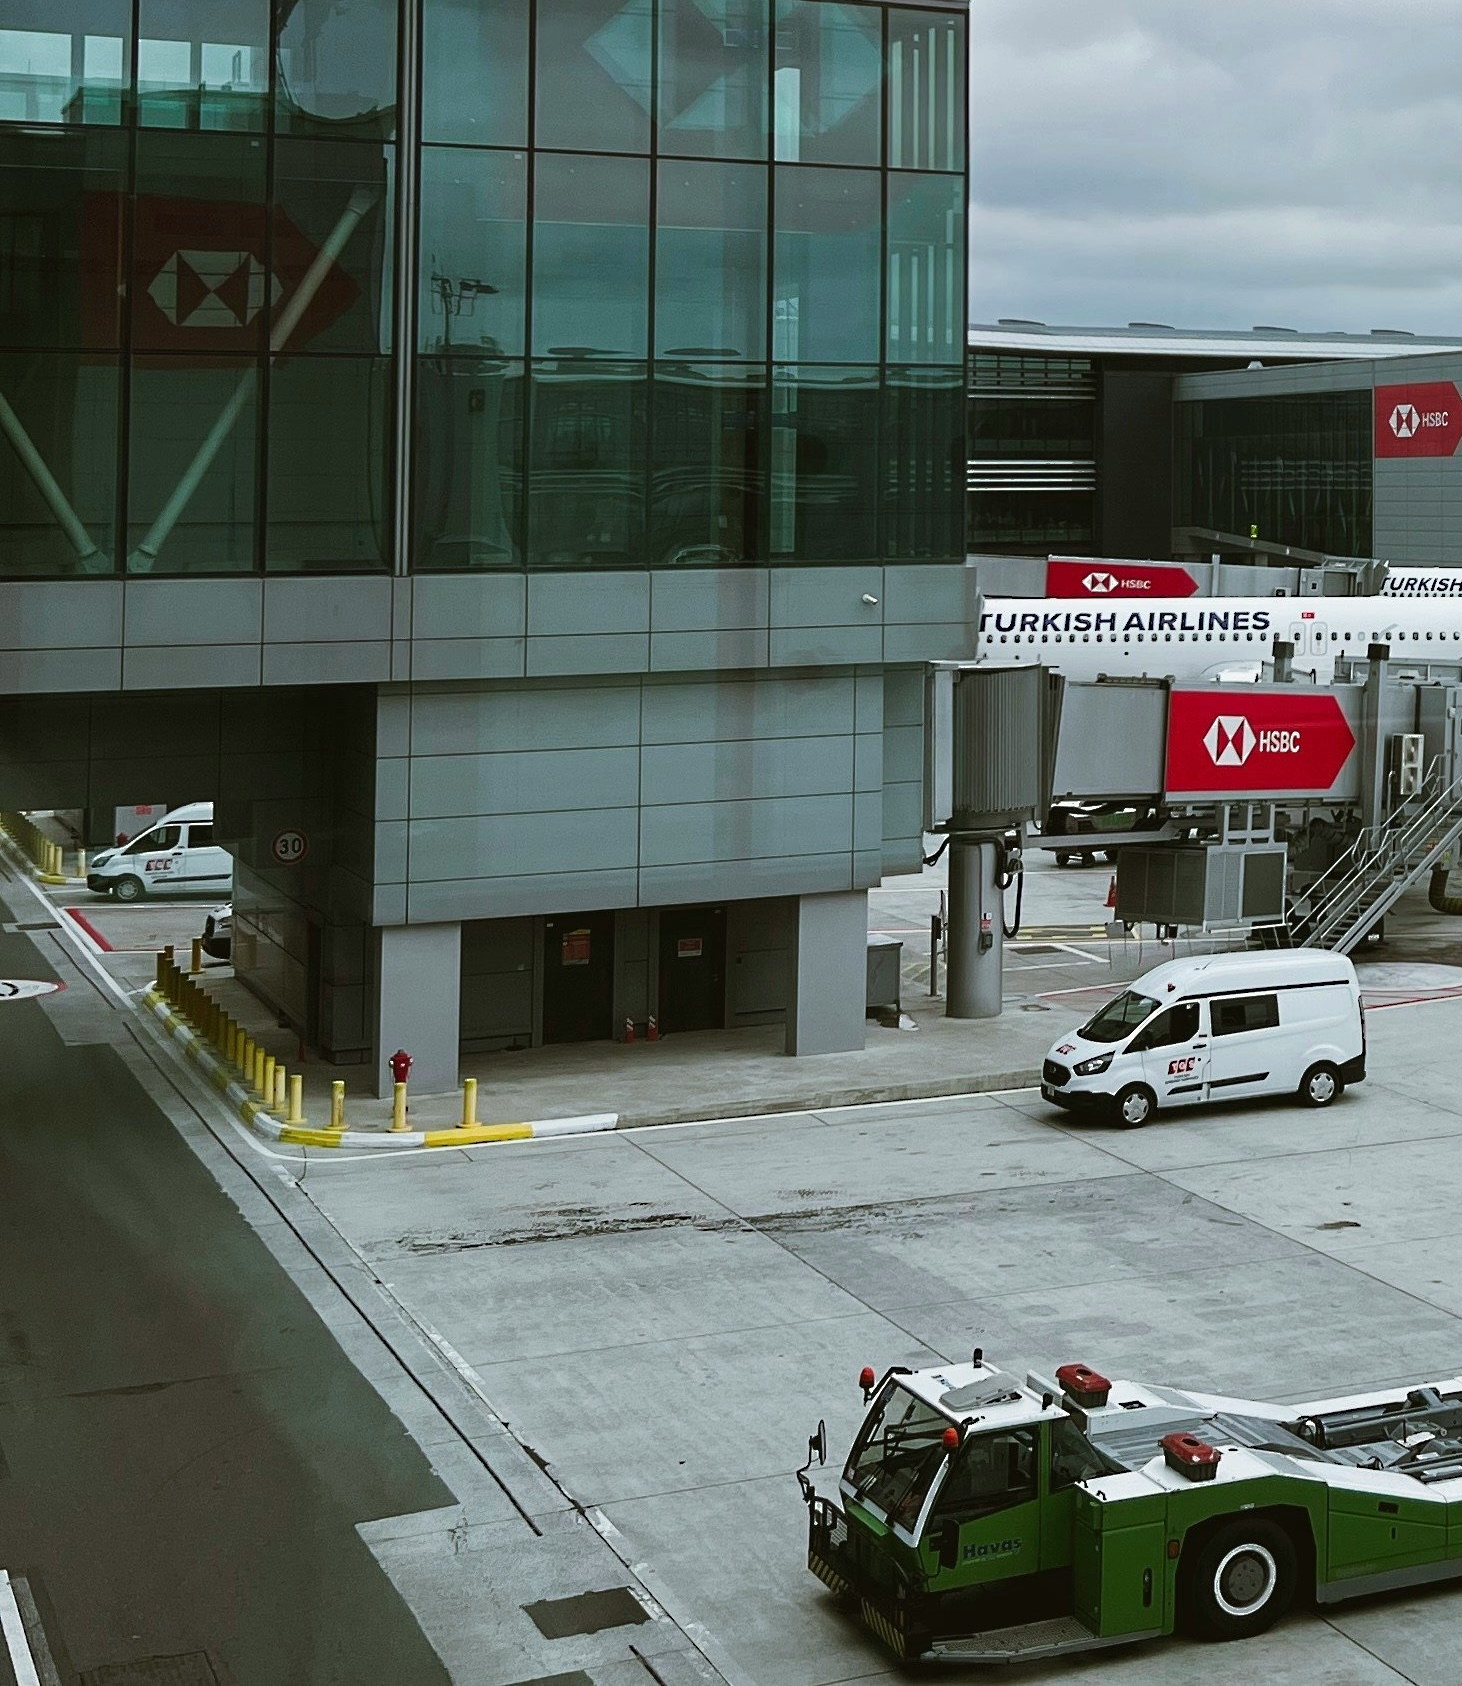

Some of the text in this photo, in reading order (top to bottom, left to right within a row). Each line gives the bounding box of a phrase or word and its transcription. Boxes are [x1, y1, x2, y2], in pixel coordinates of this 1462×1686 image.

[1422, 412, 1449, 427] HSBC
[1121, 579, 1151, 590] HSBC
[979, 612, 1270, 633] TURKISH AIRLINES
[1259, 730, 1300, 753] HSBC
[279, 837, 302, 855] 30
